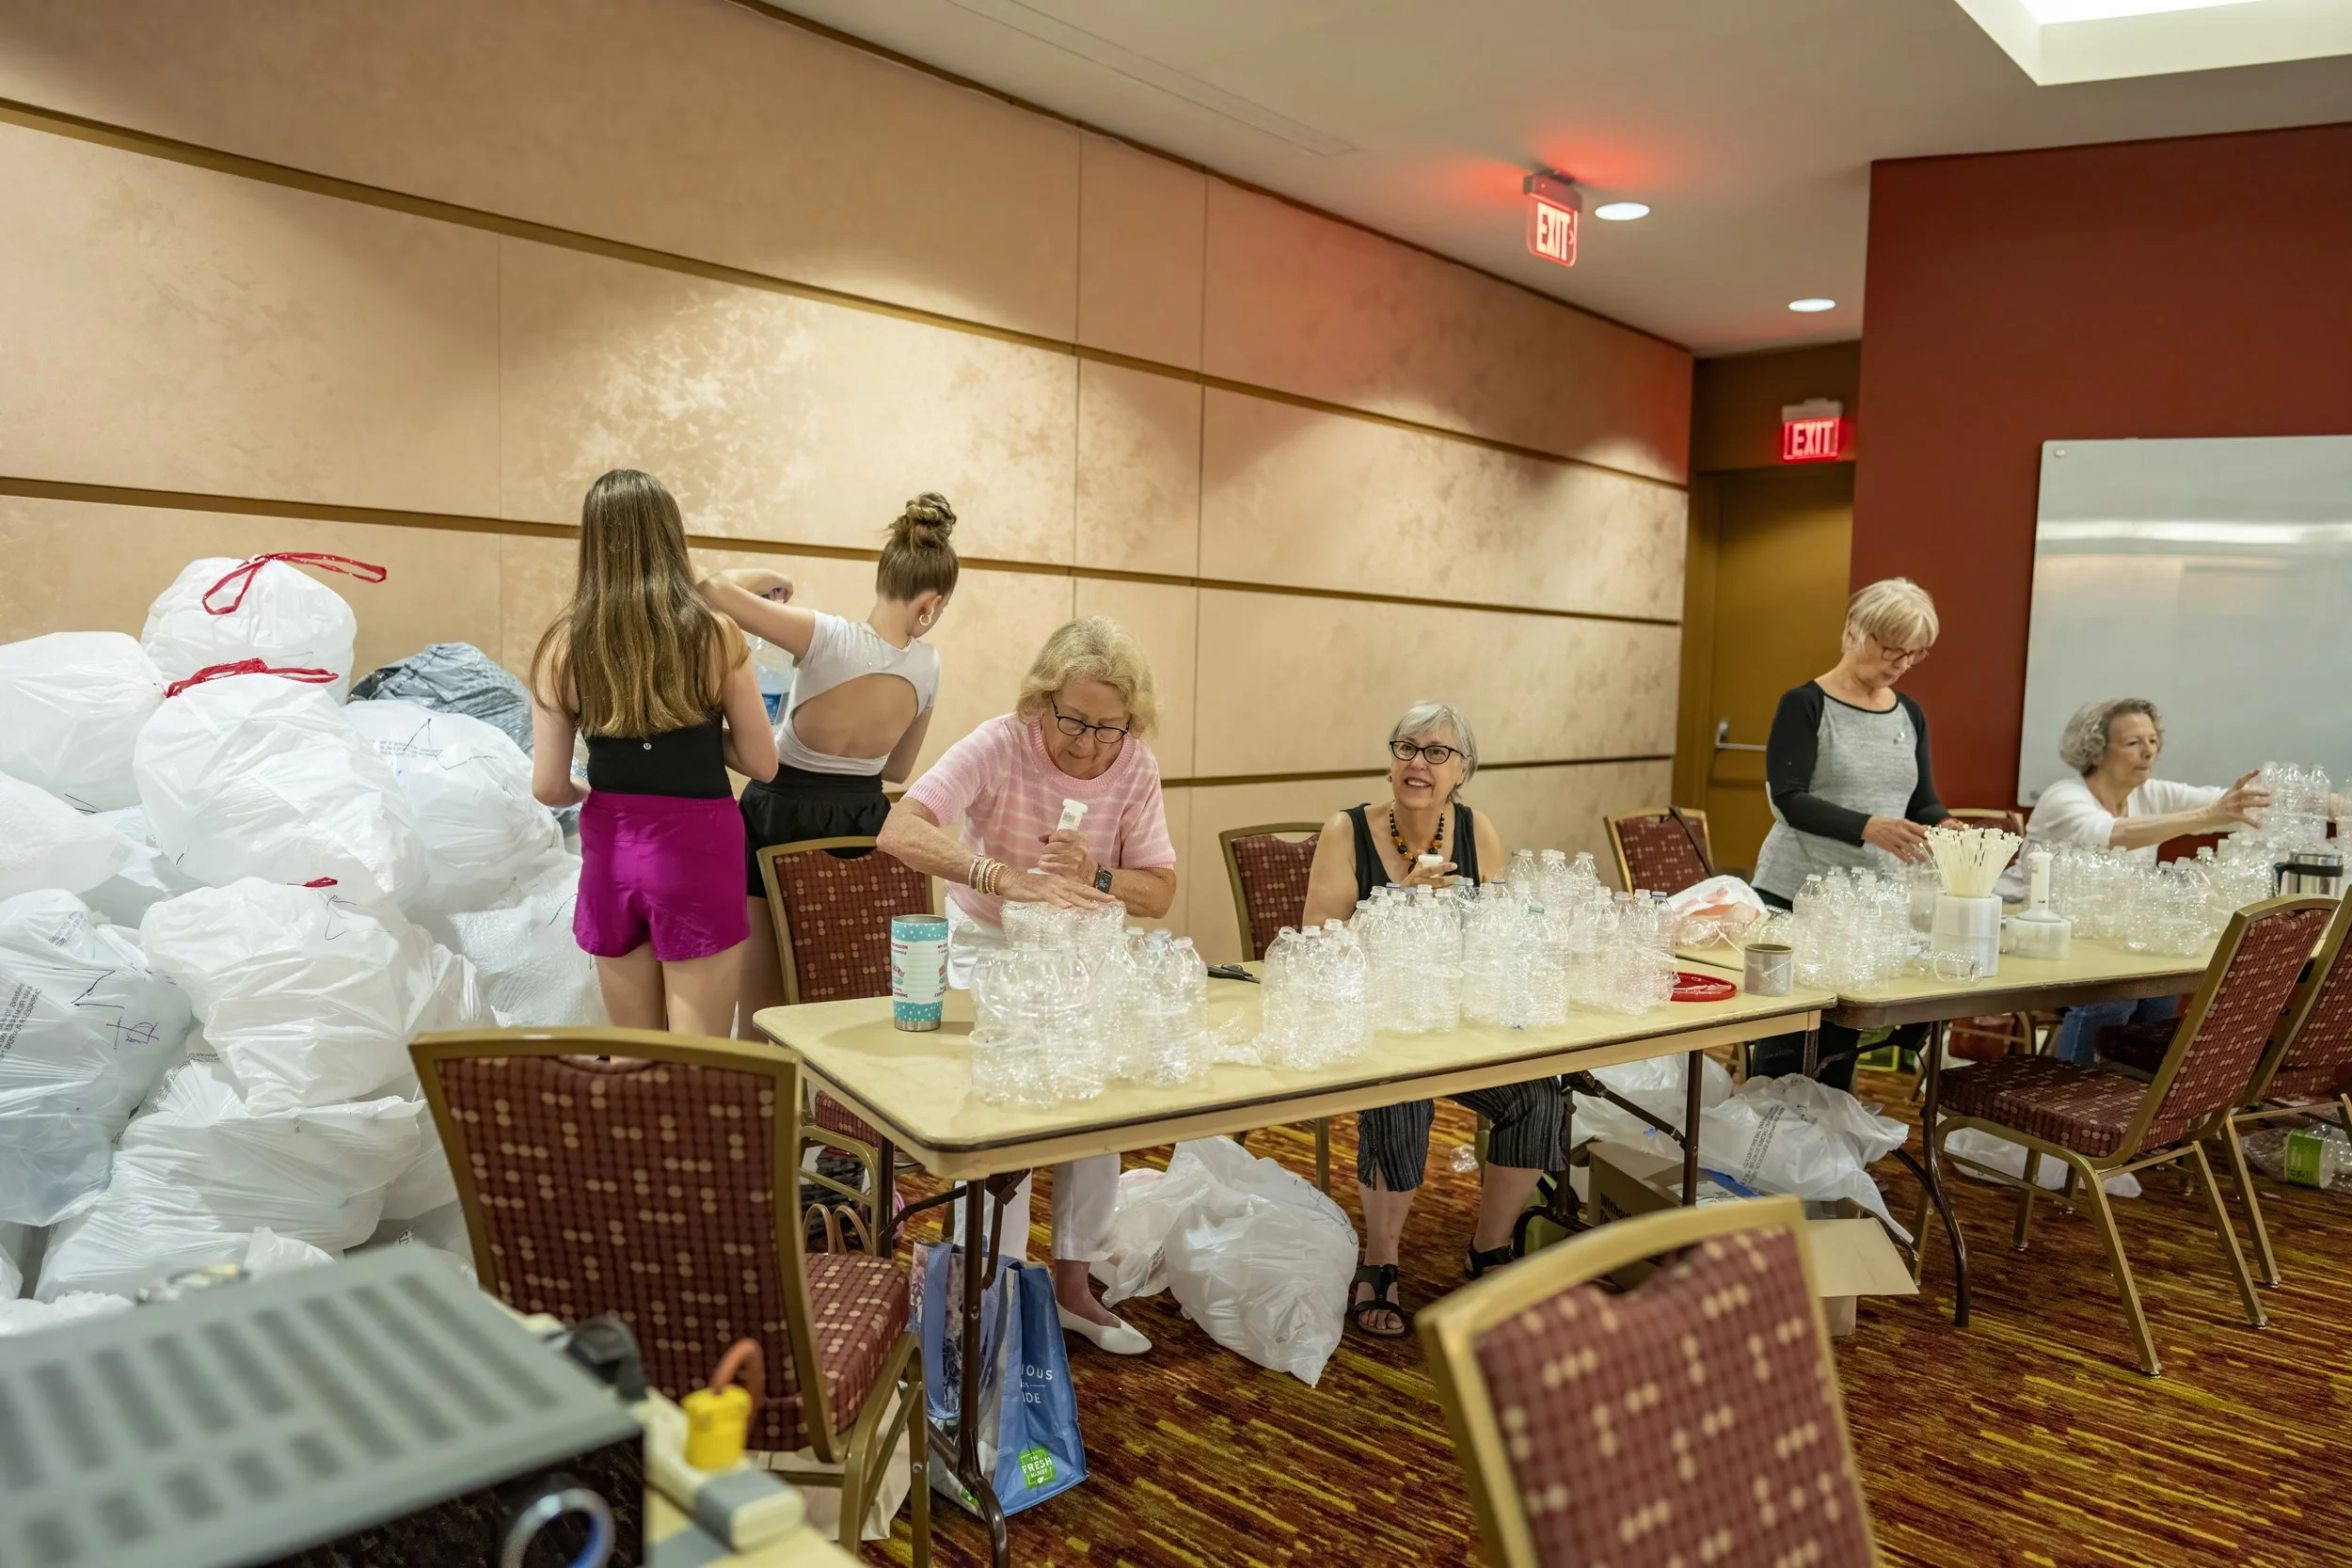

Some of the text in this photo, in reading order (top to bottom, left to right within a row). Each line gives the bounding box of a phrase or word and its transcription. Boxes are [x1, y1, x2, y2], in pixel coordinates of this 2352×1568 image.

[1536, 201, 1570, 261] EXIT
[1792, 420, 1835, 456] EXIT
[1022, 1456, 1053, 1474] FRESH
[1030, 1468, 1047, 1478] MARKET
